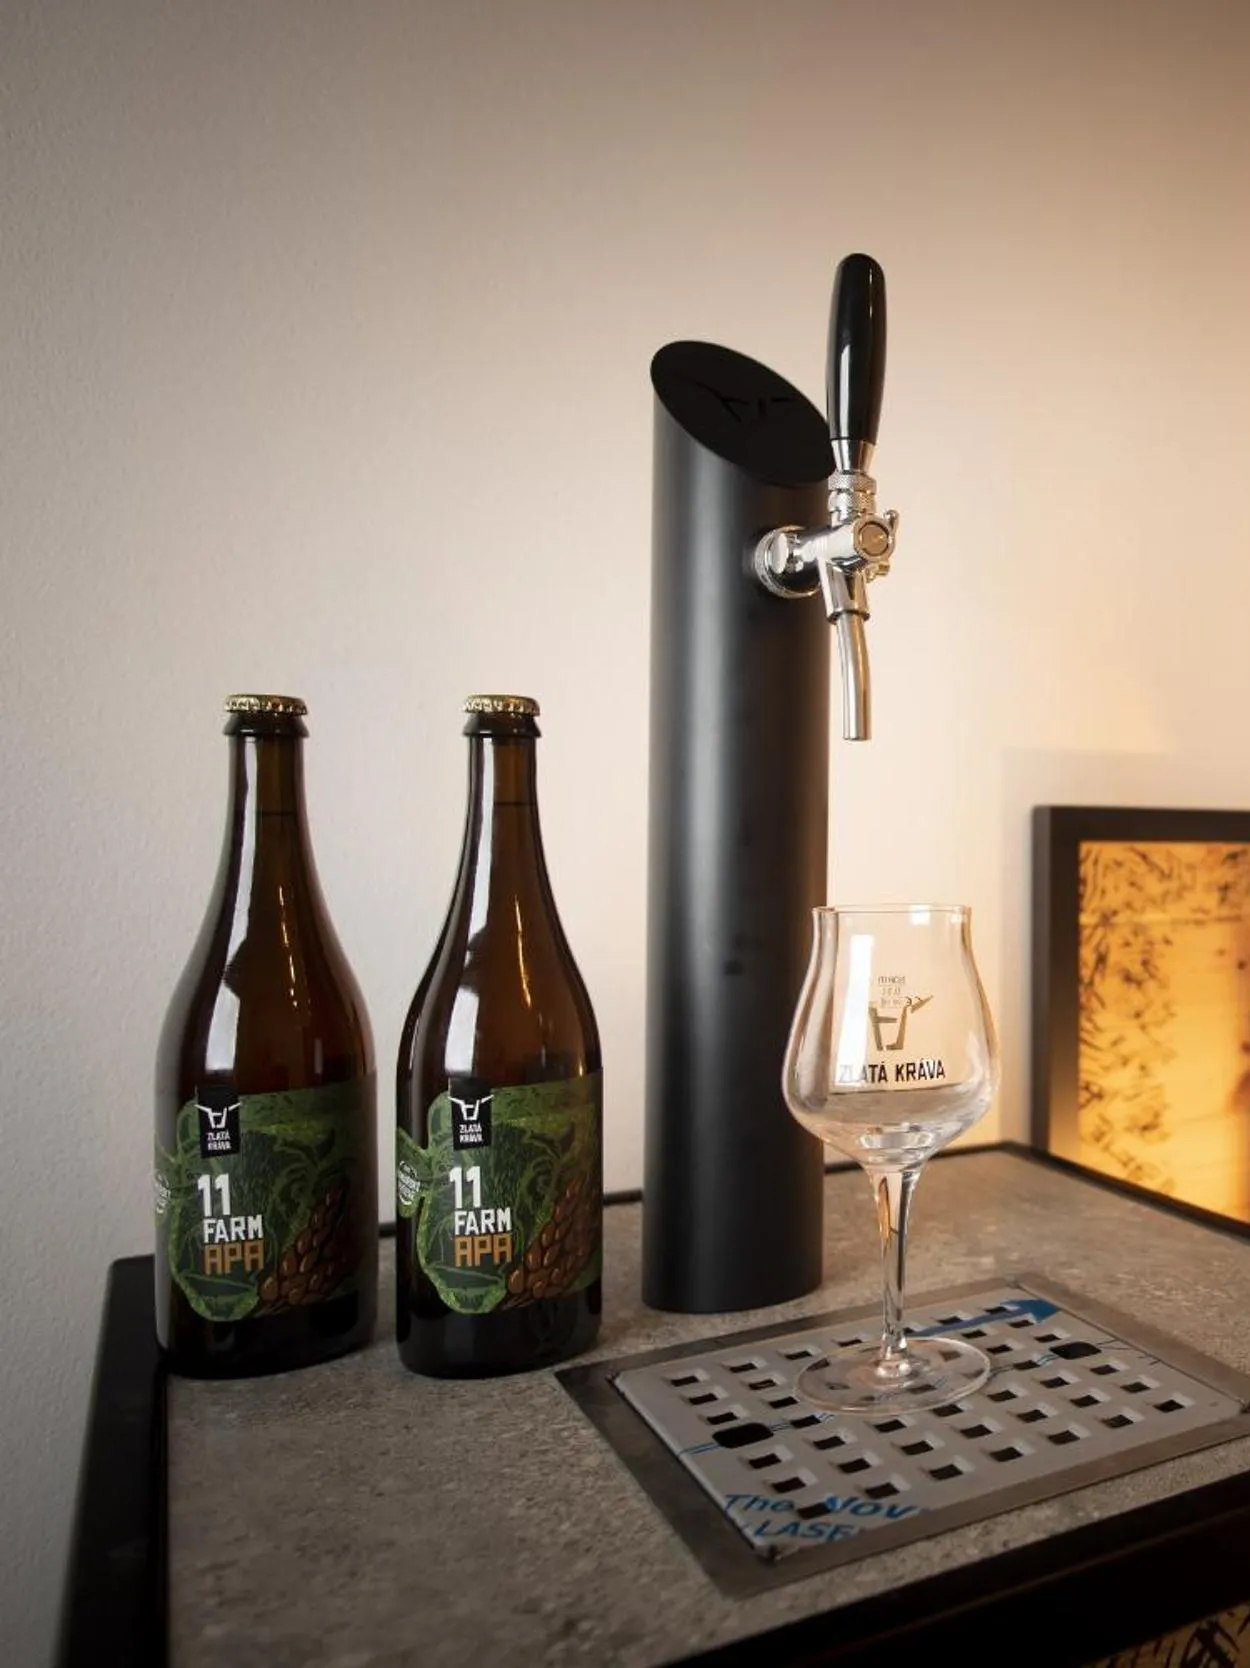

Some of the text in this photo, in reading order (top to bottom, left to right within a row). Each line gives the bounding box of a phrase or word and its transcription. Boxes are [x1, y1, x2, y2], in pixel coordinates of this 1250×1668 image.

[895, 1058, 946, 1082] KRÁVA
[198, 1173, 231, 1216] 11
[449, 1166, 482, 1208] 11
[203, 1214, 264, 1243] FARM
[454, 1207, 512, 1235] FARM
[204, 1240, 266, 1275] APA
[454, 1233, 513, 1268] APA
[725, 1494, 795, 1512] The
